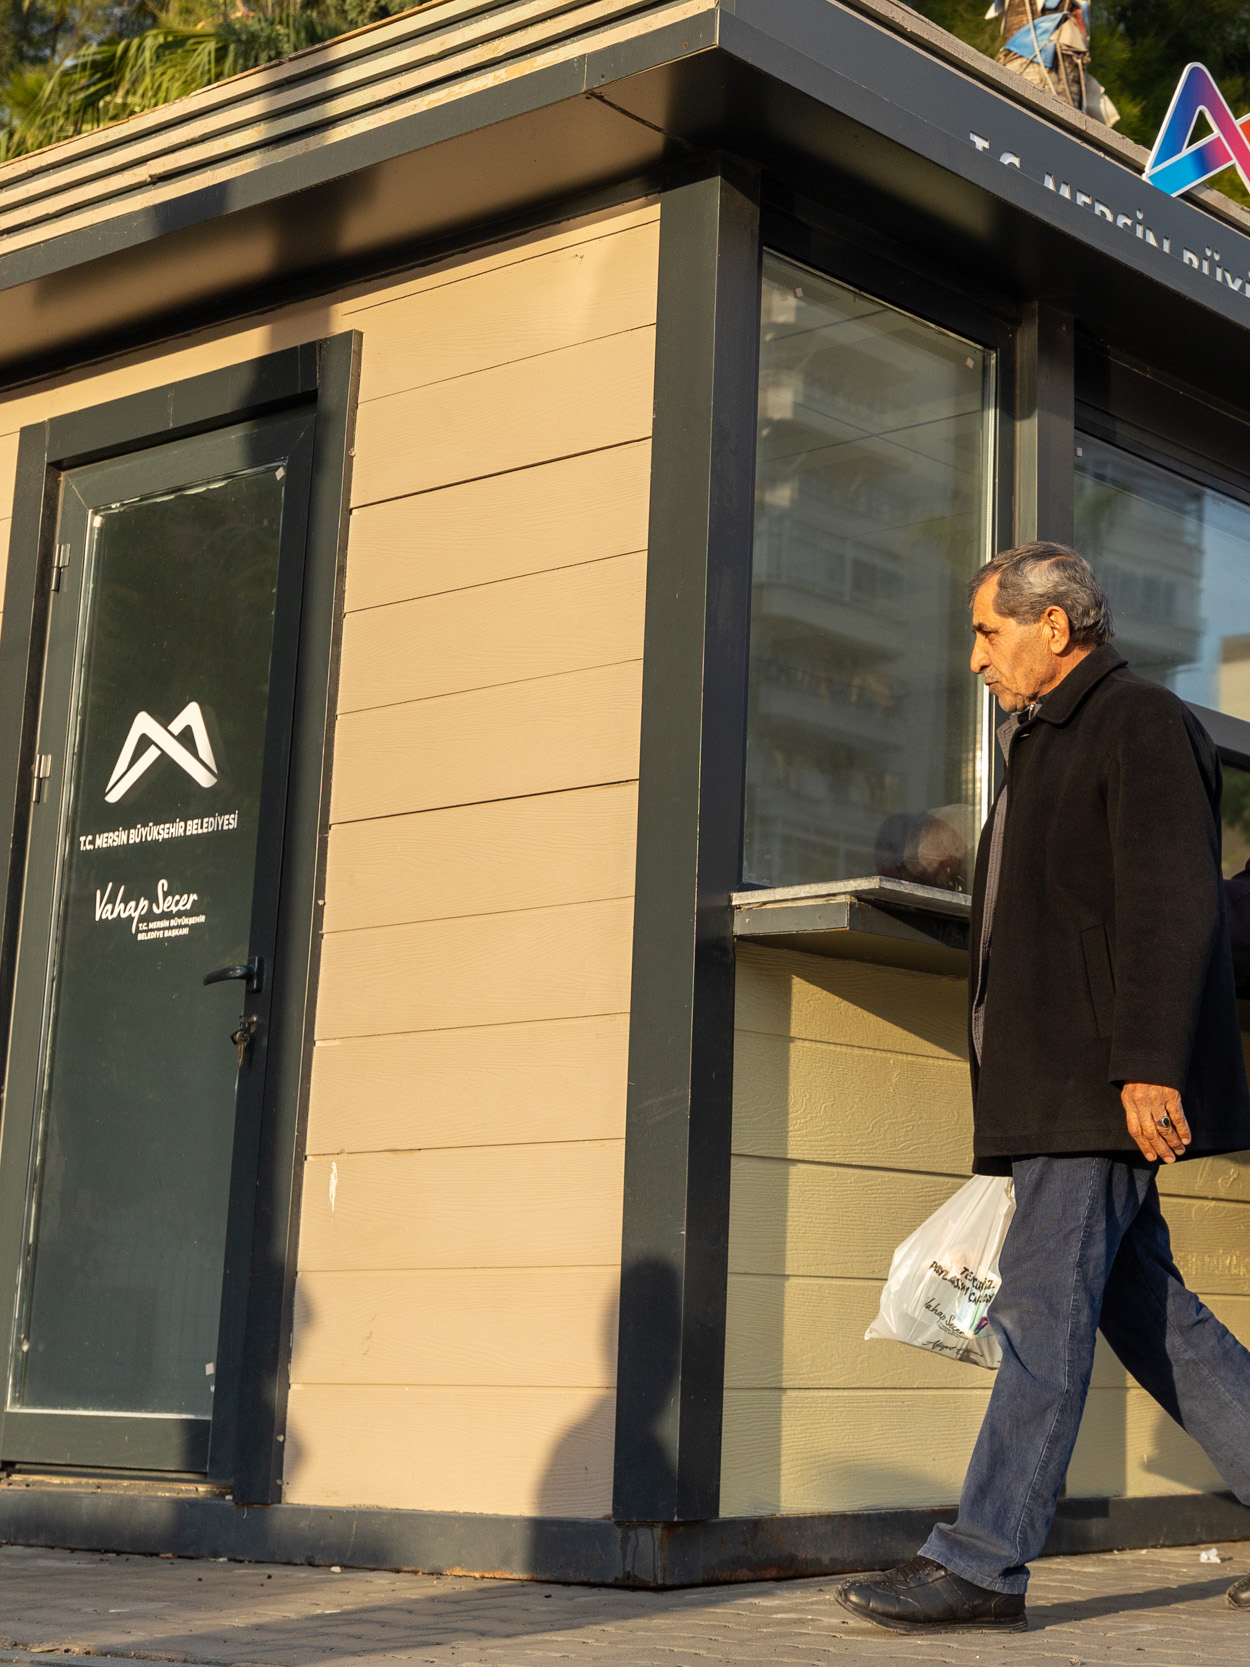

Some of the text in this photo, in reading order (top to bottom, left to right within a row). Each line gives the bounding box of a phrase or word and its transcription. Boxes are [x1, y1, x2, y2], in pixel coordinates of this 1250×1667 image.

[79, 810, 239, 851] T.C. MERSİN BÜYÜKŞEHİR BELEDİYESİ
[95, 879, 198, 934] Vahap Seçer
[148, 918, 171, 929] MERSİN
